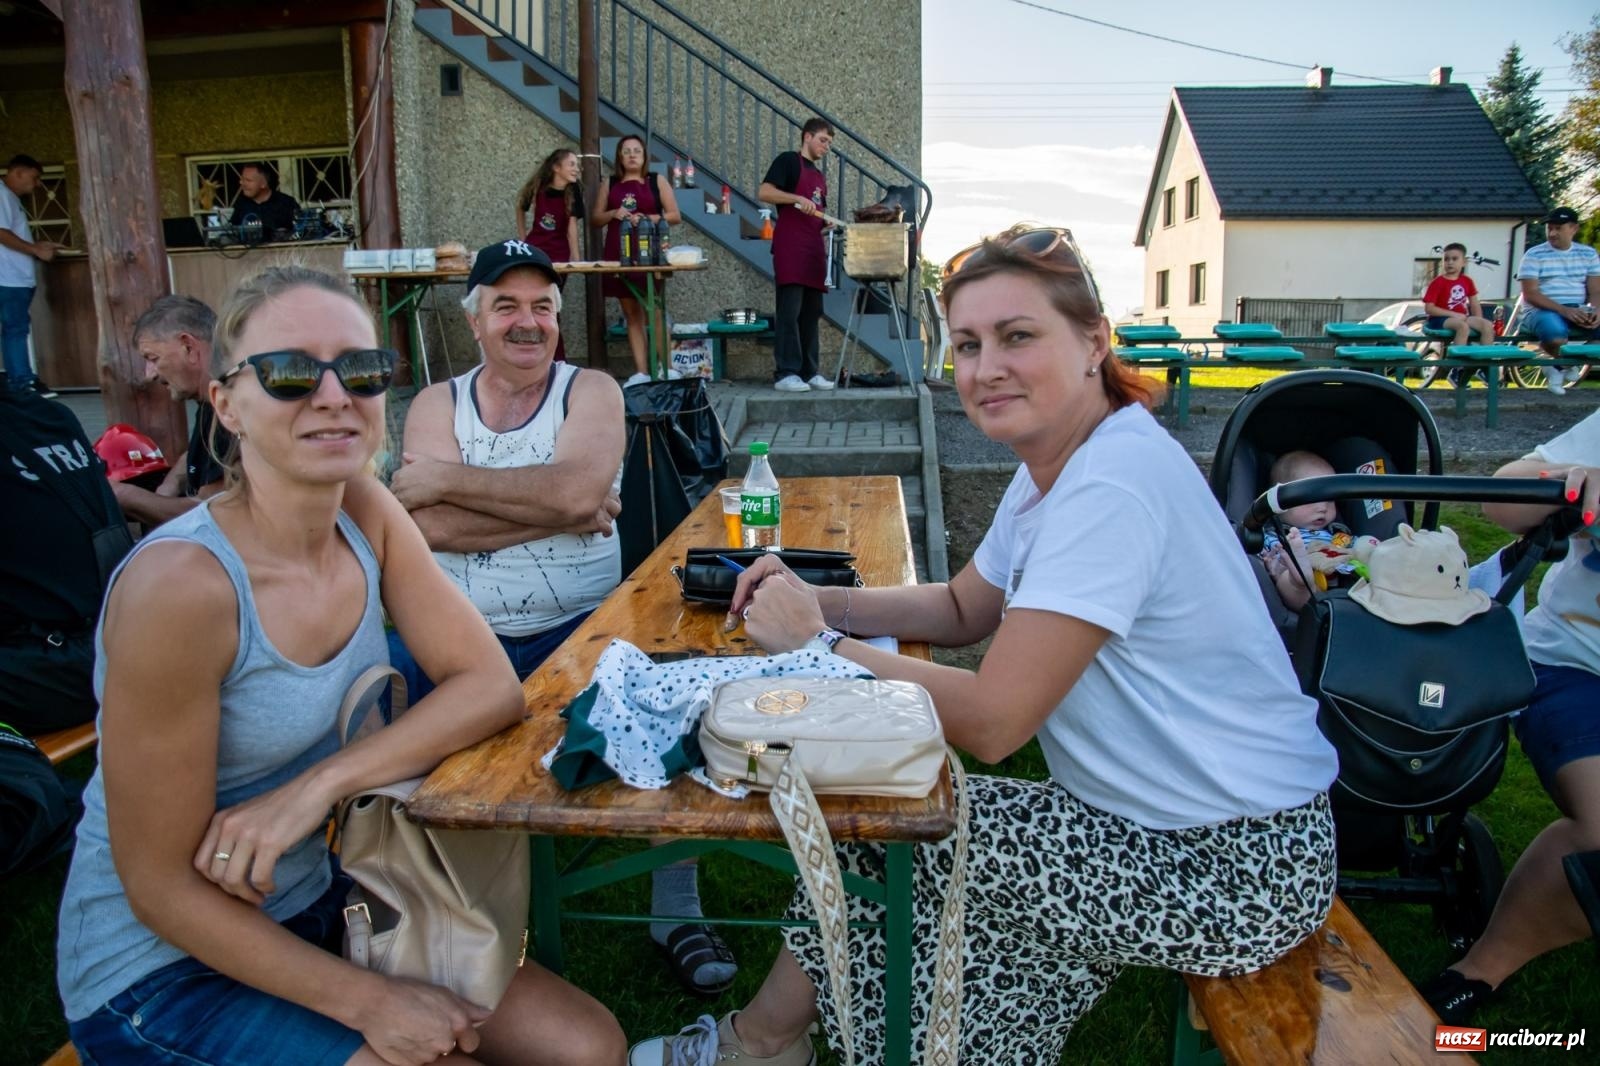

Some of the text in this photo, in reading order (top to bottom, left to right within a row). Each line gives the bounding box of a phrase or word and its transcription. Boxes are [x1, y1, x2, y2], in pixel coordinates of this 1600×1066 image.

[503, 239, 532, 256] NY
[11, 439, 101, 481] STRA
[741, 498, 761, 512] rite
